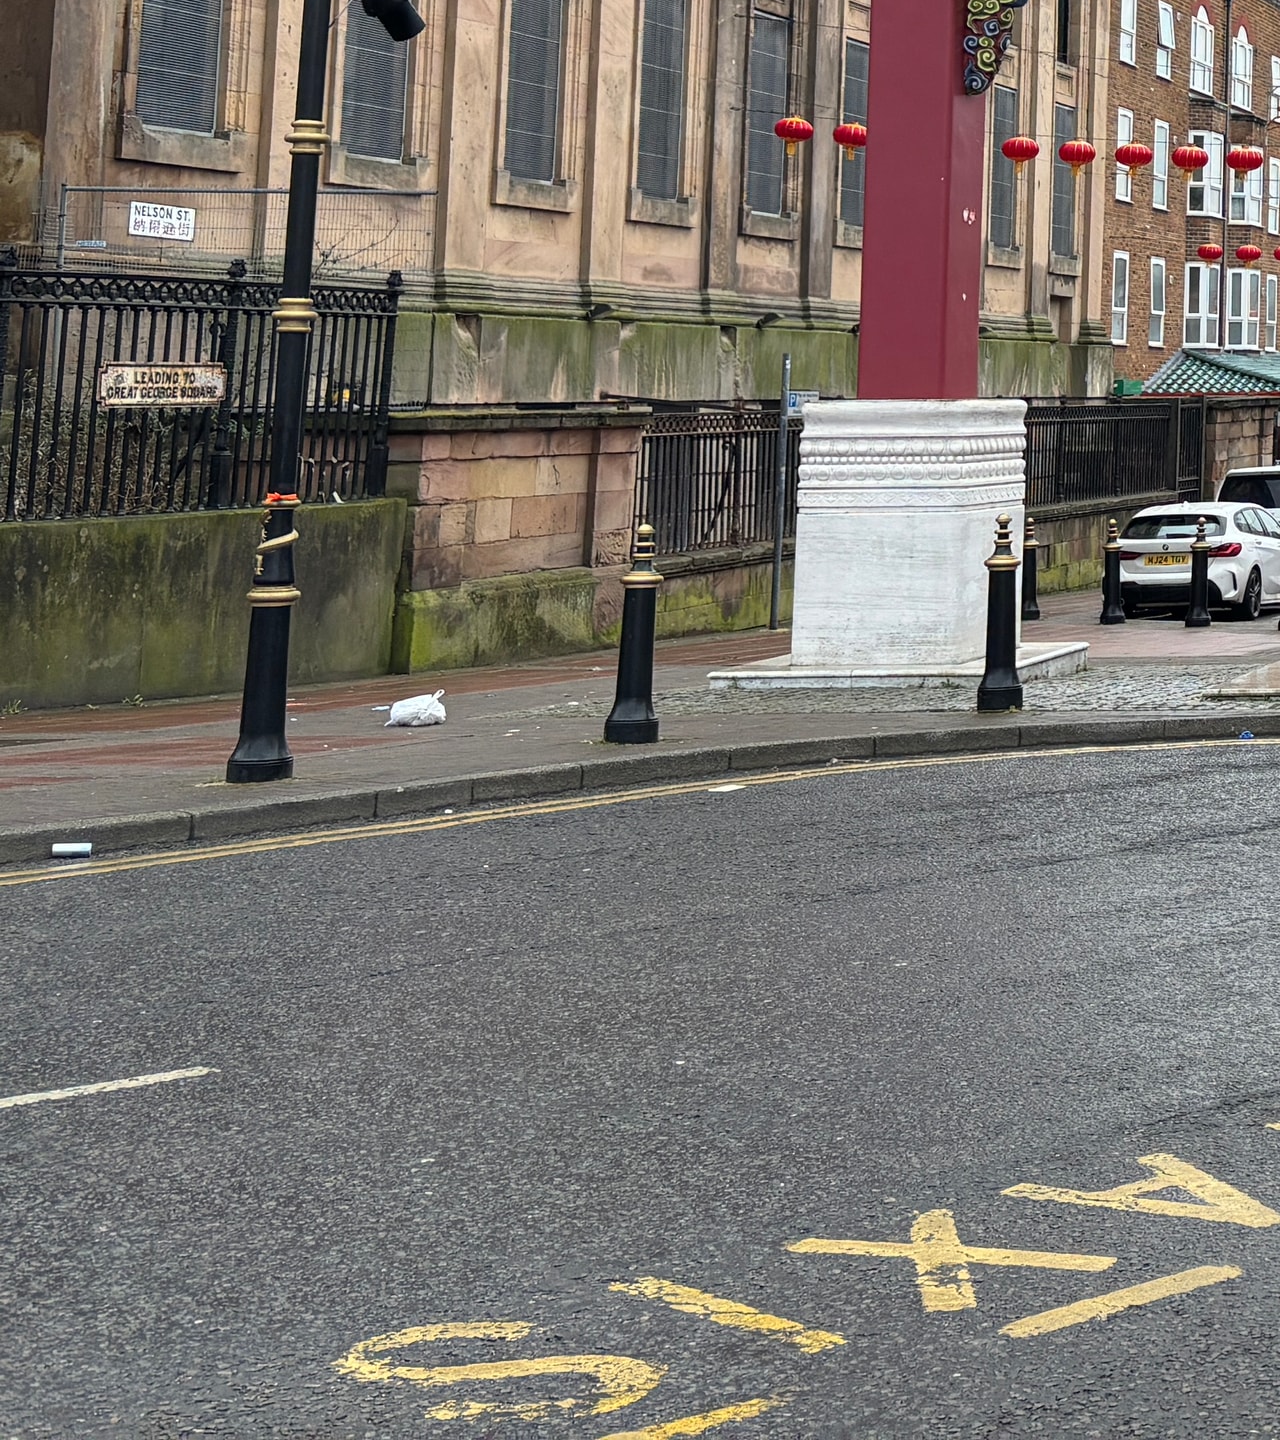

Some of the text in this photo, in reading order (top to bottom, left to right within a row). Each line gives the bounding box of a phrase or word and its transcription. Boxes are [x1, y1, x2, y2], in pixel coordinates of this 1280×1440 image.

[134, 205, 191, 221] NELSON ST.
[134, 372, 196, 384] LEADING TO
[106, 386, 218, 399] GREAT GEORGE SQUARE
